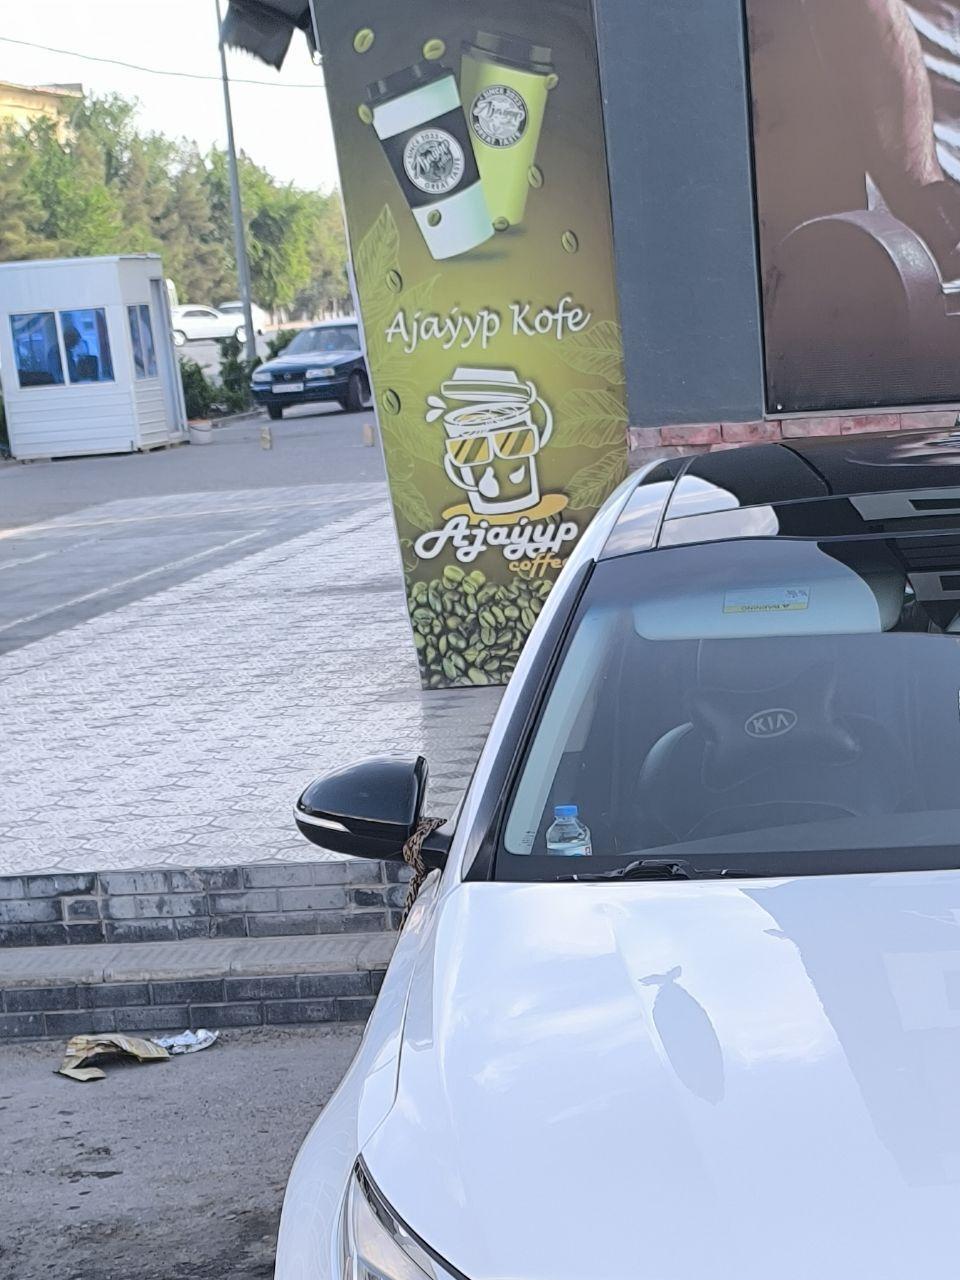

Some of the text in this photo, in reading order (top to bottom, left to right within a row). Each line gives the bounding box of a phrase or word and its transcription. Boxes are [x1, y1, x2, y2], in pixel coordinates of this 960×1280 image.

[385, 296, 591, 354] Ajaýyp Kofe
[753, 713, 790, 733] KIA
